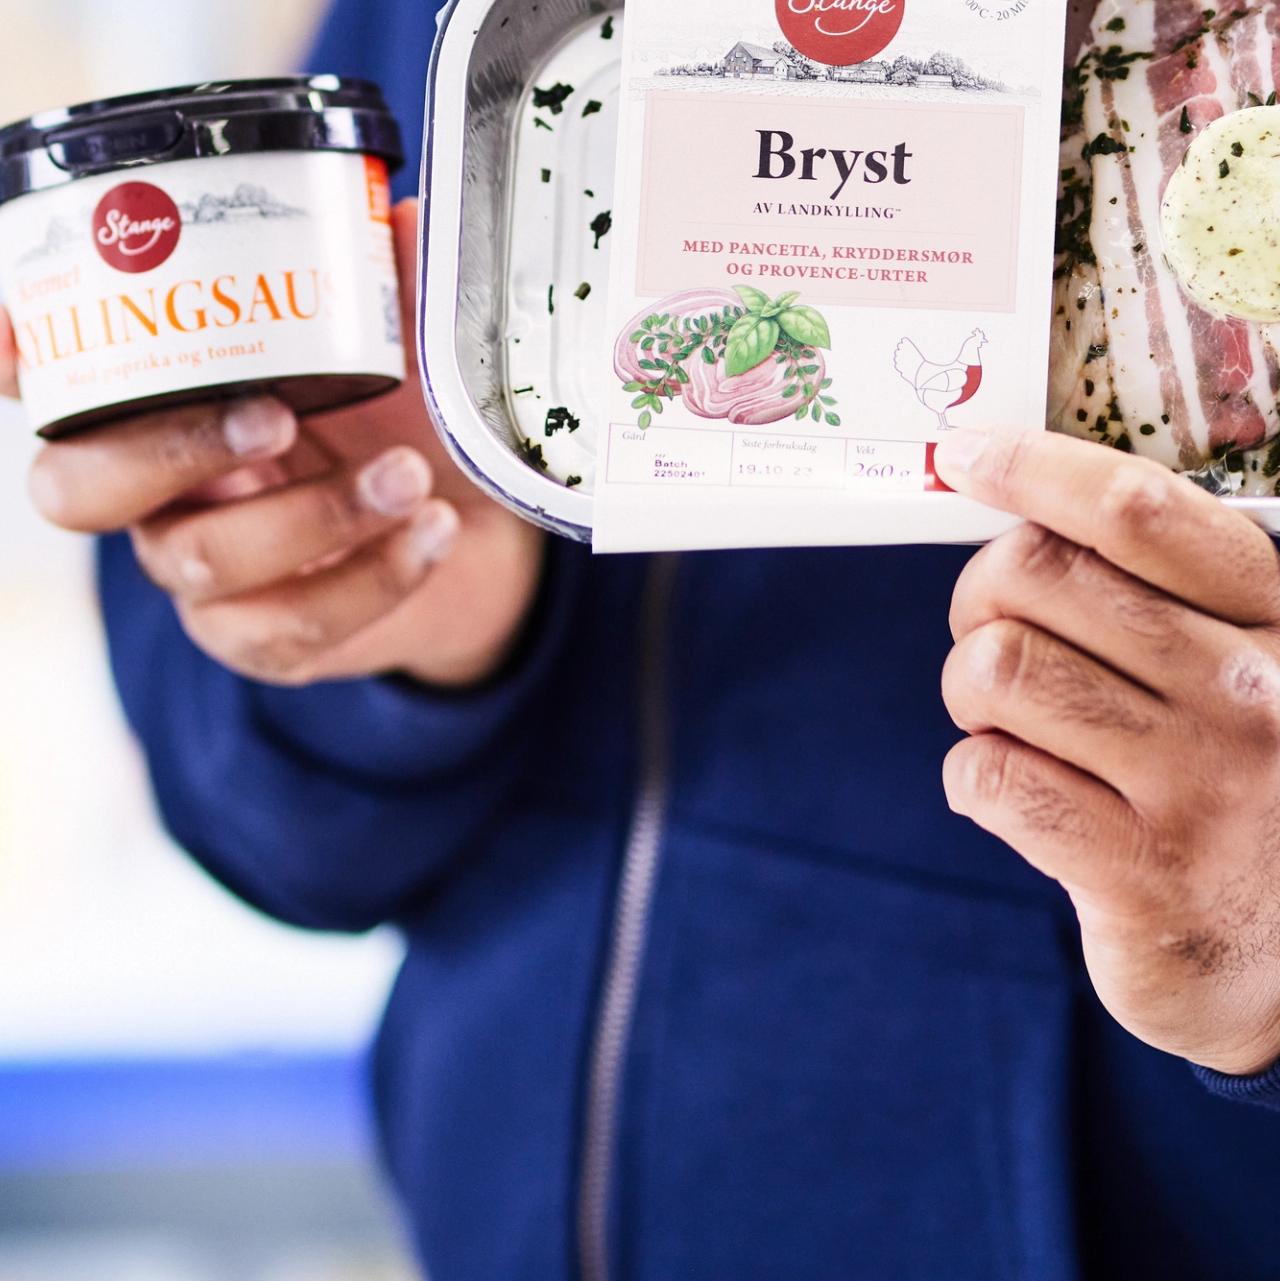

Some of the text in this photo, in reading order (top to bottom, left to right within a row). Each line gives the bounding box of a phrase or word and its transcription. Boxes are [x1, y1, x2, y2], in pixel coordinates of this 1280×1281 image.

[996, 10, 1010, 21] 20
[752, 129, 913, 201] Bryst
[753, 202, 773, 215] AV
[97, 208, 175, 256] Stange
[682, 239, 975, 265] MED PANCETTA, KRYDDERSMØR
[726, 261, 929, 284] OG PROVENCE-URTER
[18, 269, 334, 374] YLLINGSAU
[178, 351, 201, 369] og
[207, 338, 266, 361] tomat
[856, 445, 876, 456] Vekt
[654, 459, 688, 469] Batch
[854, 462, 894, 479] 260
